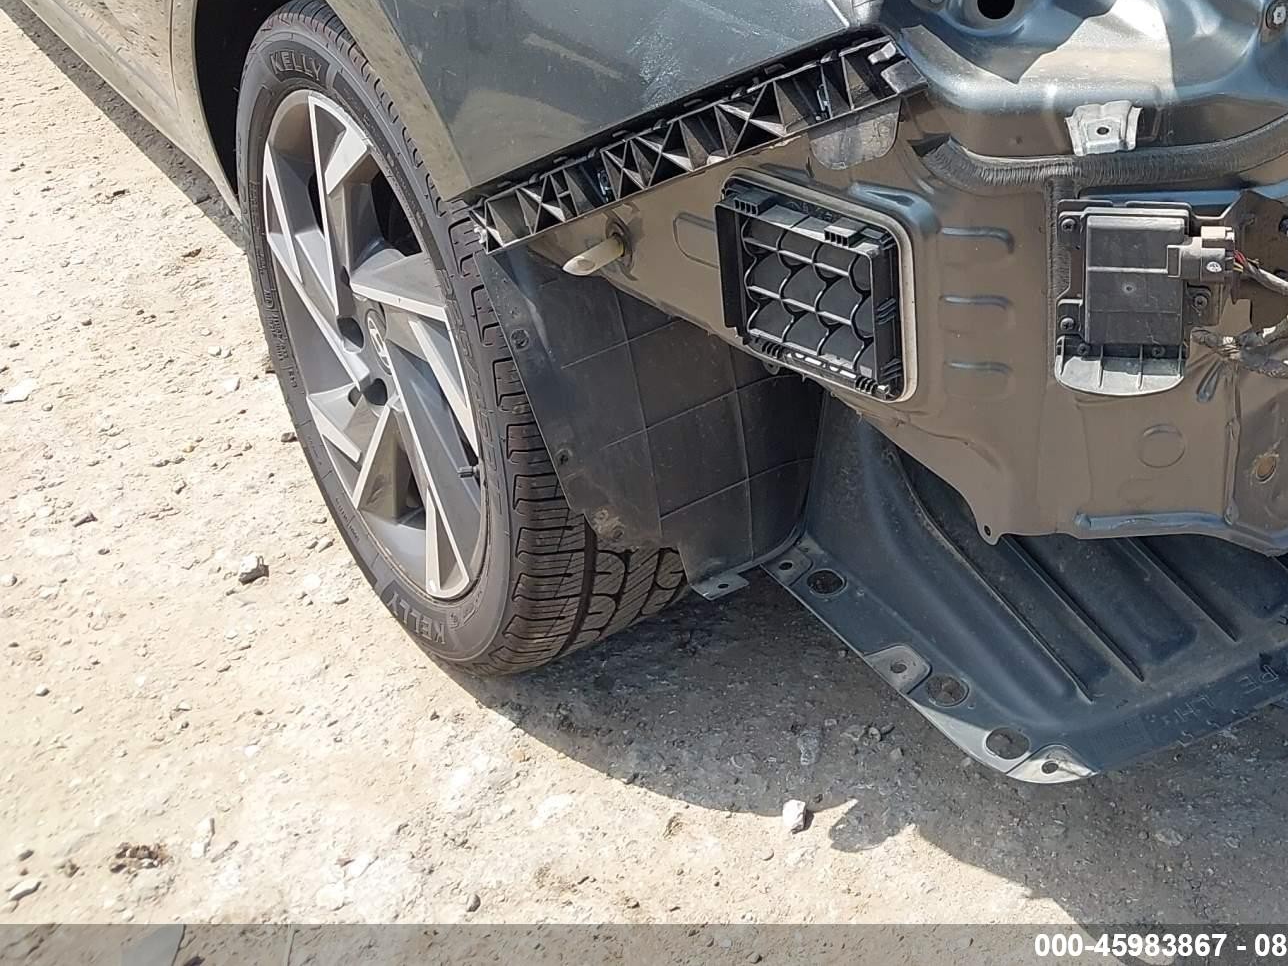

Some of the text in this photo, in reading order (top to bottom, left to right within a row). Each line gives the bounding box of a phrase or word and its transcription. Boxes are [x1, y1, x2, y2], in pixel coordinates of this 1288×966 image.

[270, 48, 323, 82] KELLY
[386, 591, 446, 645] KELLY
[1237, 663, 1280, 695] PE
[1173, 694, 1216, 722] LH
